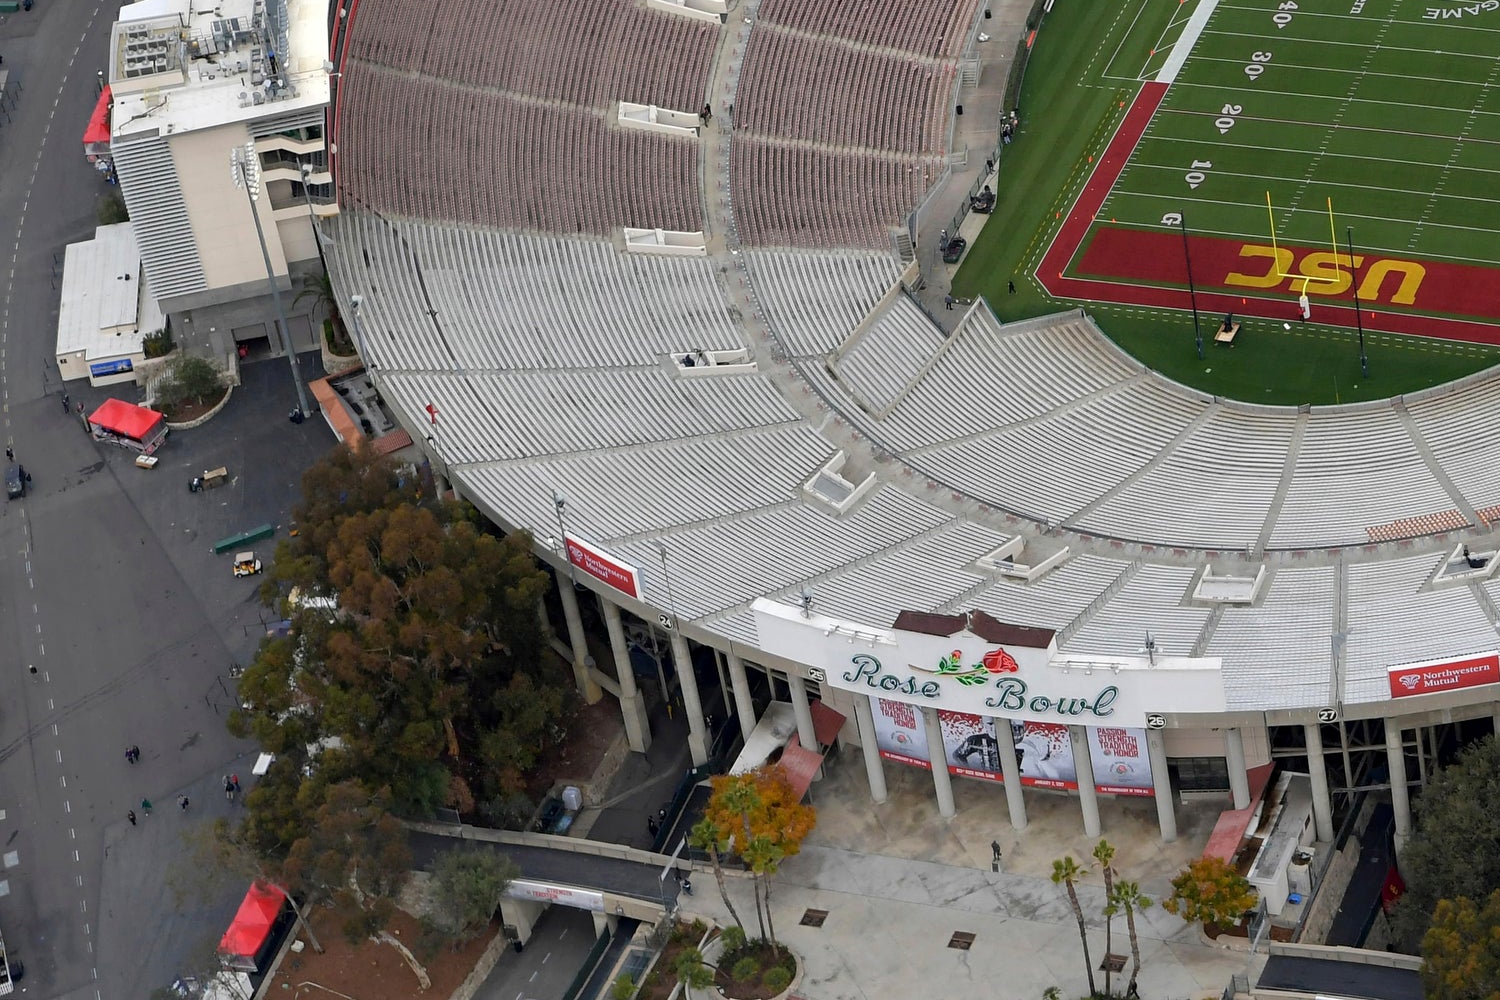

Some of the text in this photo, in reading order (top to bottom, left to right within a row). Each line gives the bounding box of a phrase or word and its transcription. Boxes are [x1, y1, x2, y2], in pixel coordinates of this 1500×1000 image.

[1273, 1, 1298, 24] 40
[1422, 0, 1499, 20] GAME
[1244, 51, 1272, 76] 30
[1215, 104, 1242, 129] 20
[1185, 160, 1212, 184] 10
[1161, 213, 1182, 226] G
[1224, 243, 1426, 305] USC
[584, 553, 628, 583] Northwestern
[586, 560, 608, 578] Mutual
[660, 615, 672, 629] 24
[809, 669, 824, 680] 25
[1423, 664, 1490, 680] Northwestern
[842, 653, 1120, 717] Rose Bowl
[1424, 676, 1459, 688] Mutual
[1149, 715, 1165, 726] 26
[1320, 709, 1336, 721] 27
[1097, 727, 1127, 736] PASSION
[1098, 734, 1137, 742] STRENGTH
[1099, 741, 1138, 750] TRADITION
[1114, 749, 1139, 758] HONOR
